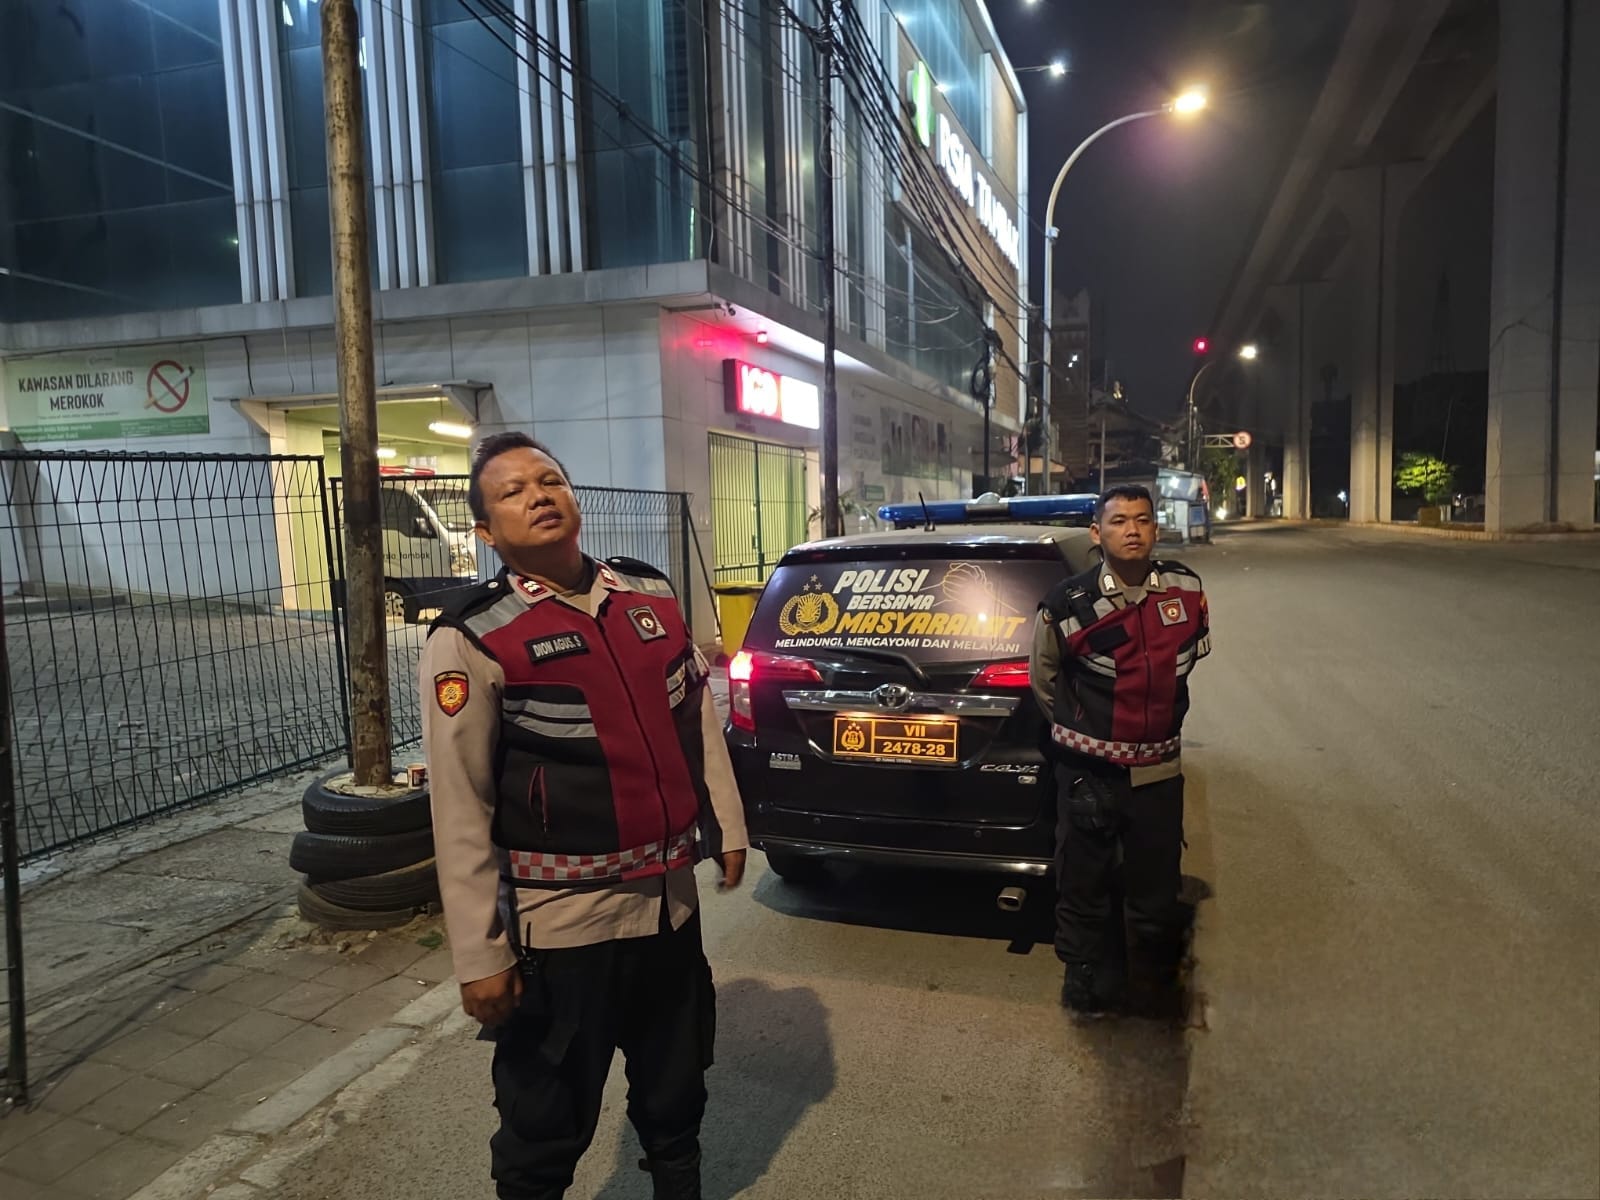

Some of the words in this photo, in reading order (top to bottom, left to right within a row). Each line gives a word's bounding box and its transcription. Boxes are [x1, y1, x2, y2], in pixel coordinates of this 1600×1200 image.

[18, 375, 73, 393] KAWASAN
[76, 371, 134, 389] DILARANG
[50, 393, 104, 411] MEROKOK
[833, 568, 930, 594] POLISI
[846, 594, 935, 611] BERSAMA
[573, 634, 582, 647] S
[775, 638, 844, 649] MELINDUNGI,
[846, 637, 920, 649] MENGAYOMI
[922, 638, 950, 649] DAN
[953, 640, 1020, 654] MELAYANI
[904, 724, 926, 737] VII
[882, 741, 946, 756] 2478-28
